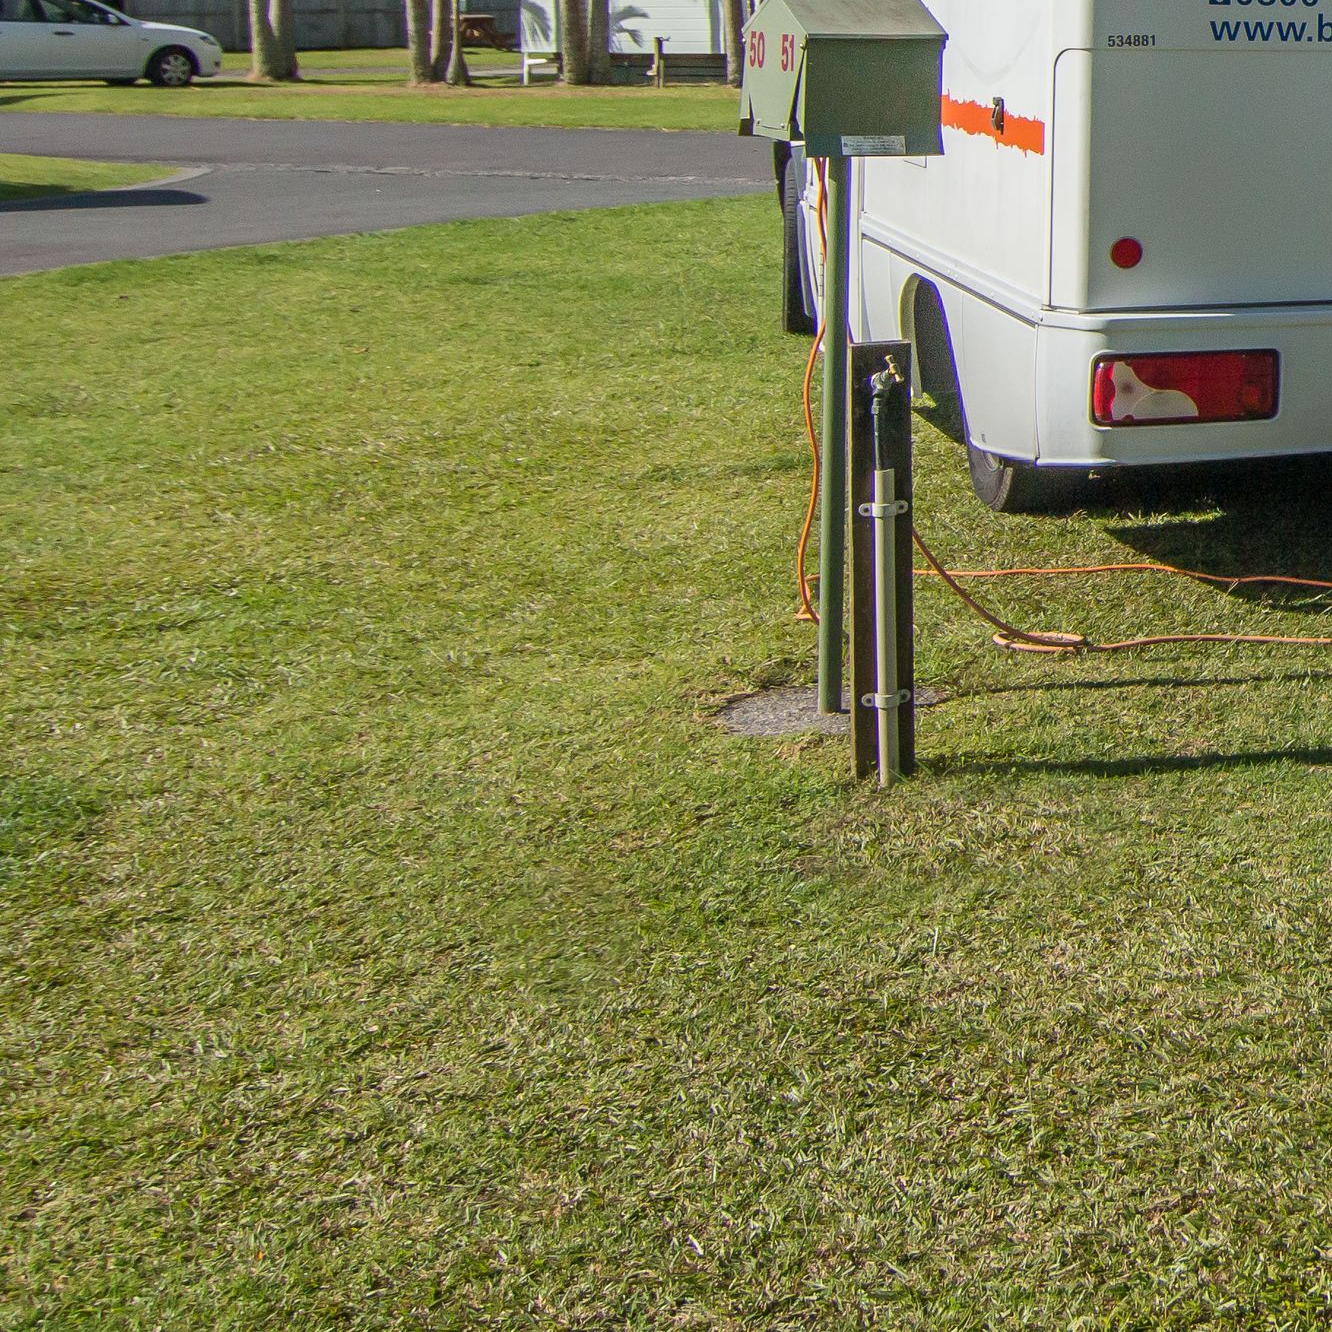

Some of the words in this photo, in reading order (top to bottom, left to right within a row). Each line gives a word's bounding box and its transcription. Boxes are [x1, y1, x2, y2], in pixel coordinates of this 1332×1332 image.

[749, 30, 765, 68] 50
[781, 34, 796, 72] 51
[1107, 34, 1156, 48] 534881
